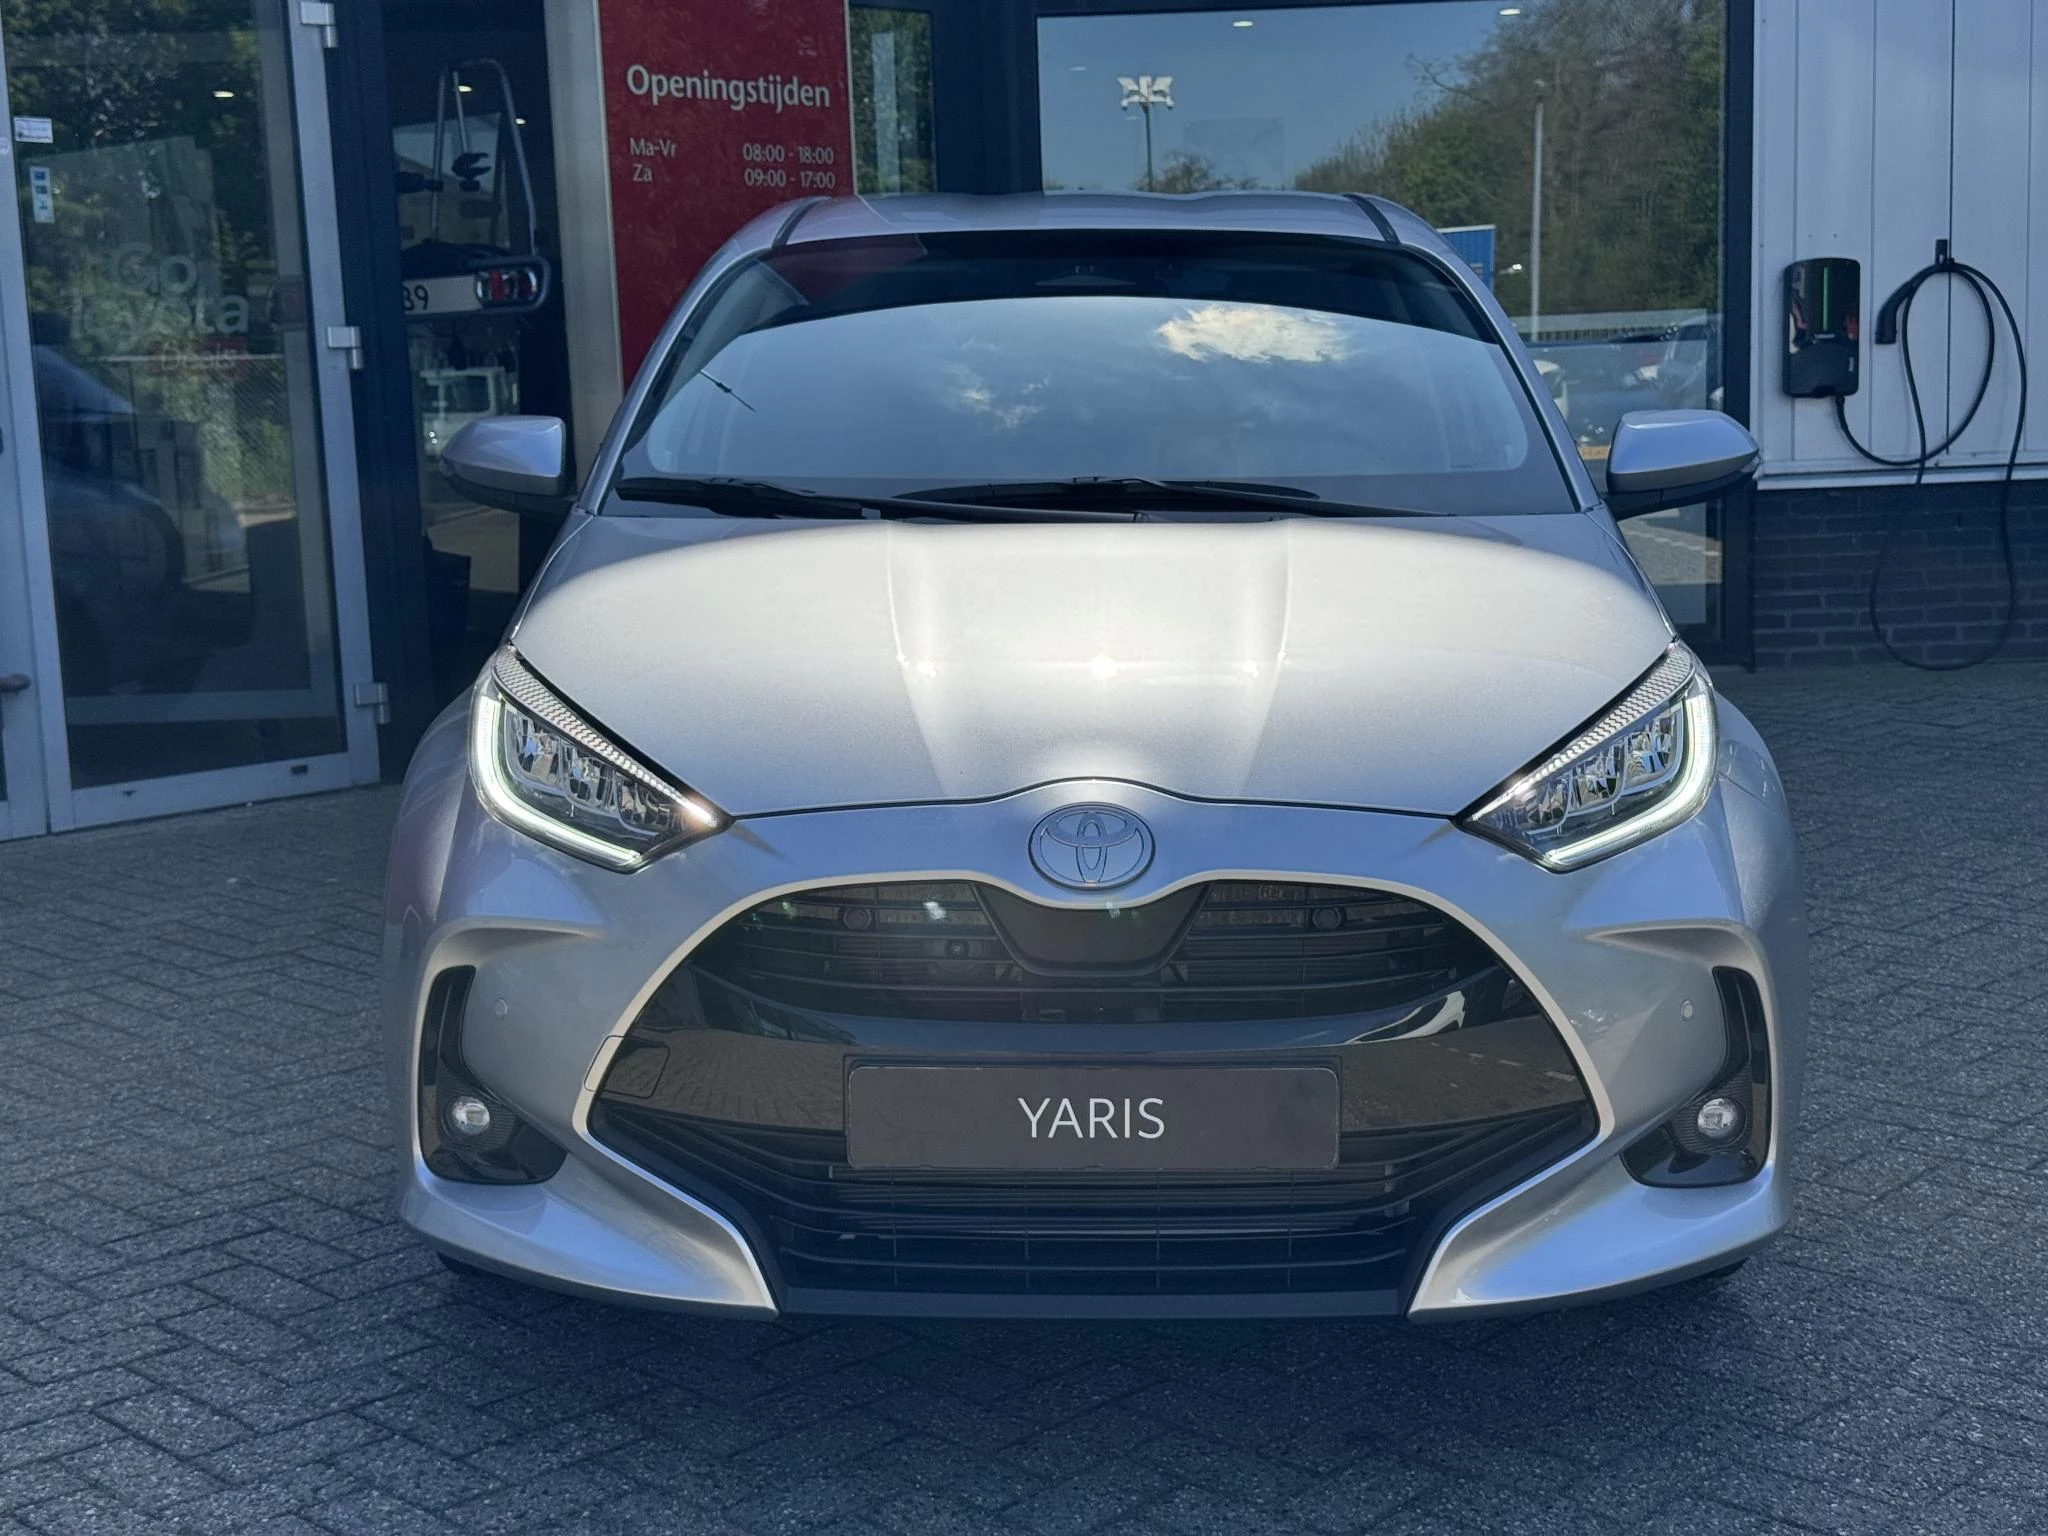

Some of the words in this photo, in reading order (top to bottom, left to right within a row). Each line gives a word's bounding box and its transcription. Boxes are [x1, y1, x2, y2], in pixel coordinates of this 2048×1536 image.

[627, 64, 830, 113] Openingstijden
[630, 137, 677, 158] Ma-Vr
[743, 143, 785, 163] 08:00
[798, 146, 834, 165] 18:00
[633, 163, 653, 182] Za
[744, 168, 786, 188] 09:00
[799, 171, 836, 189] 17:00
[1017, 1097, 1165, 1139] YARIS
